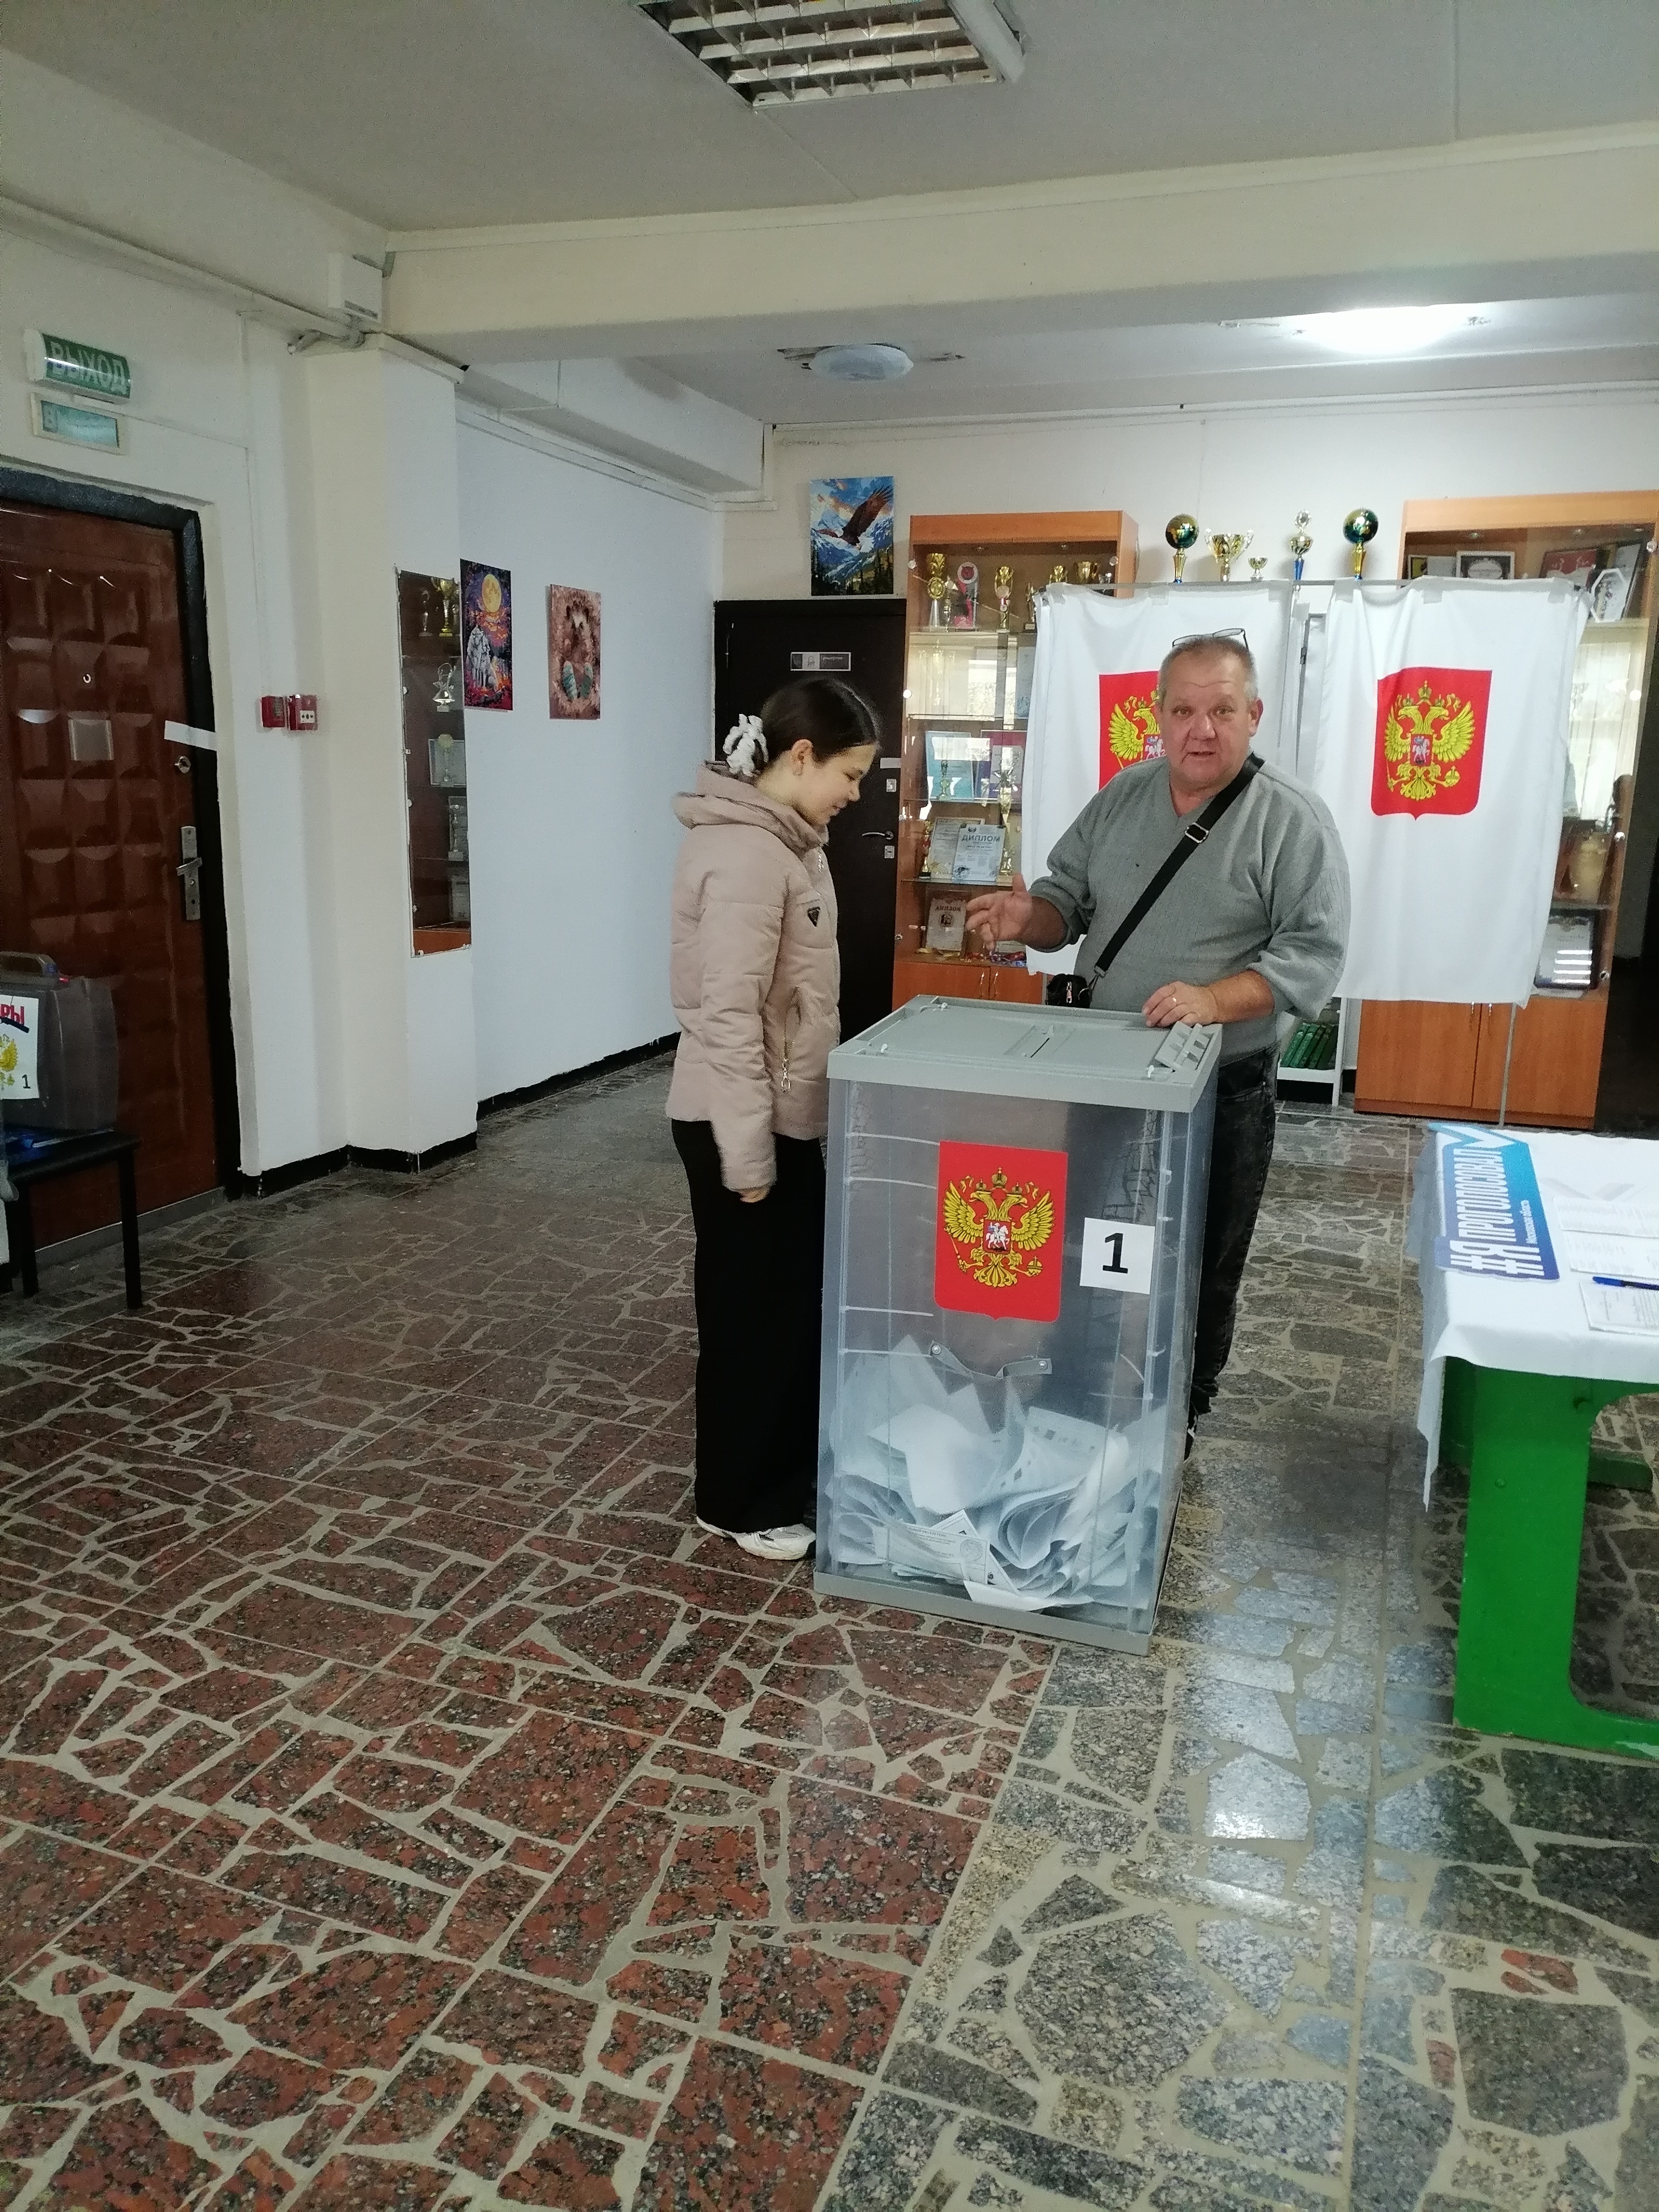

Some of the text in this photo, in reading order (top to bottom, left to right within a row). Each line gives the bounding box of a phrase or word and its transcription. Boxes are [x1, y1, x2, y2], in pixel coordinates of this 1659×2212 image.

[50, 341, 127, 395] ВЫХОД
[22, 1074, 31, 1089] 1
[1102, 1232, 1128, 1273] 1
